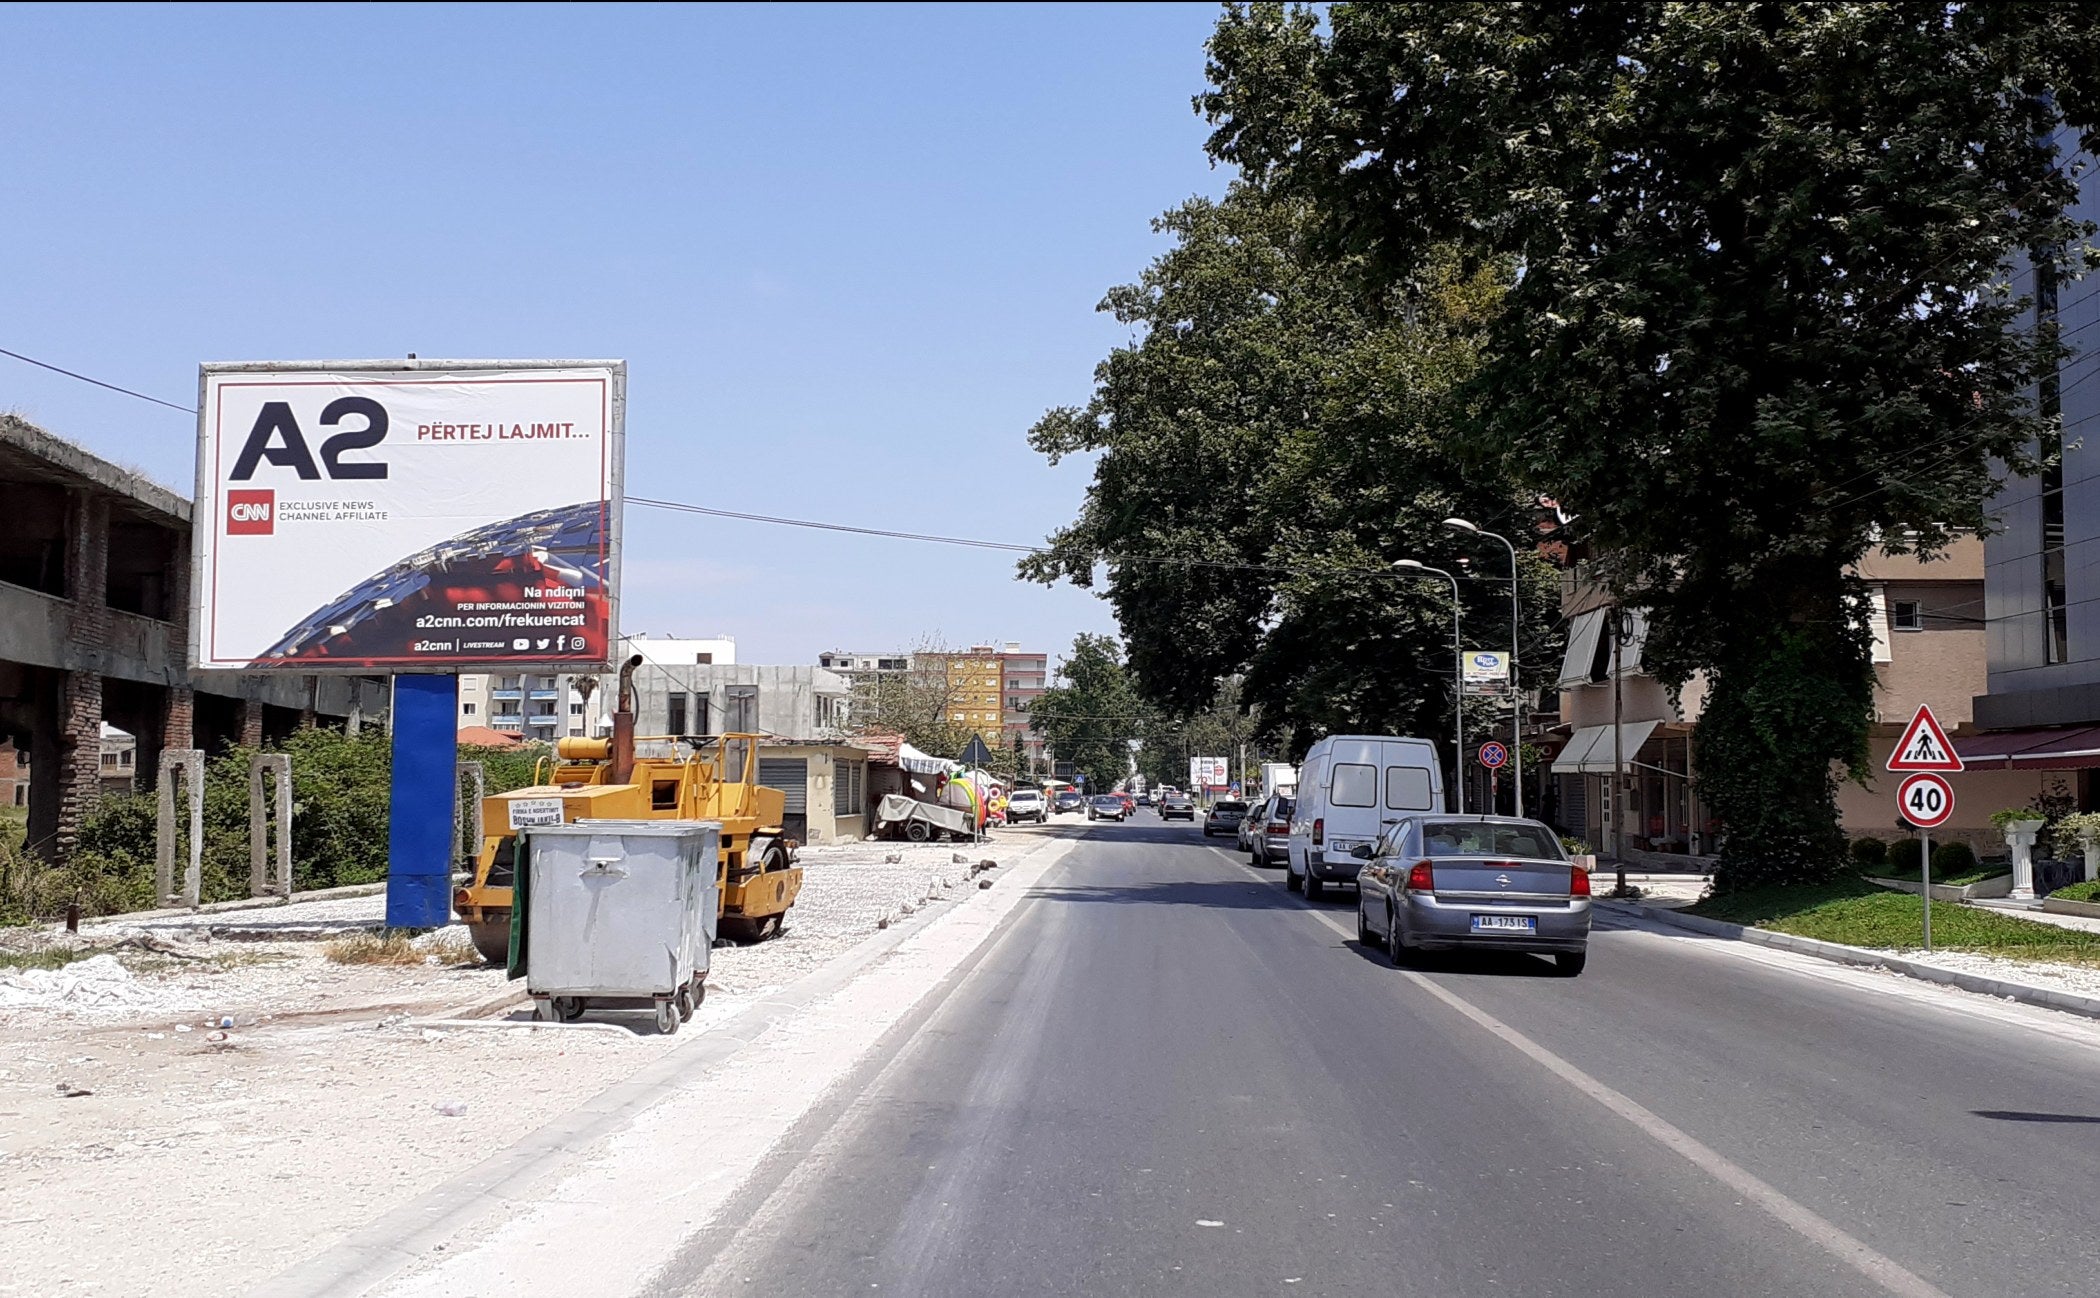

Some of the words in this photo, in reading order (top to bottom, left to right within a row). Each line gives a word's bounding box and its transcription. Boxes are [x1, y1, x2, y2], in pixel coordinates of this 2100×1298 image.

[417, 421, 492, 440] PËRTEJ
[228, 396, 389, 481] A2
[231, 503, 270, 521] CNN
[279, 501, 338, 511] EXCLUSIVE
[342, 501, 374, 510] NEWS
[279, 512, 331, 521] CHANNEL
[335, 511, 388, 520] AFFILIATE
[524, 586, 542, 598] Na
[545, 586, 585, 600] ndiqni
[457, 603, 474, 611] PER
[476, 602, 546, 610] INFORMACIONIN
[547, 602, 585, 610] VIZITONI
[416, 613, 585, 628] a2cnn.com/frekuencat
[414, 640, 452, 651] a2cnn
[1910, 787, 1942, 812] 40
[1481, 917, 1493, 927] AA
[1517, 918, 1528, 928] IS
